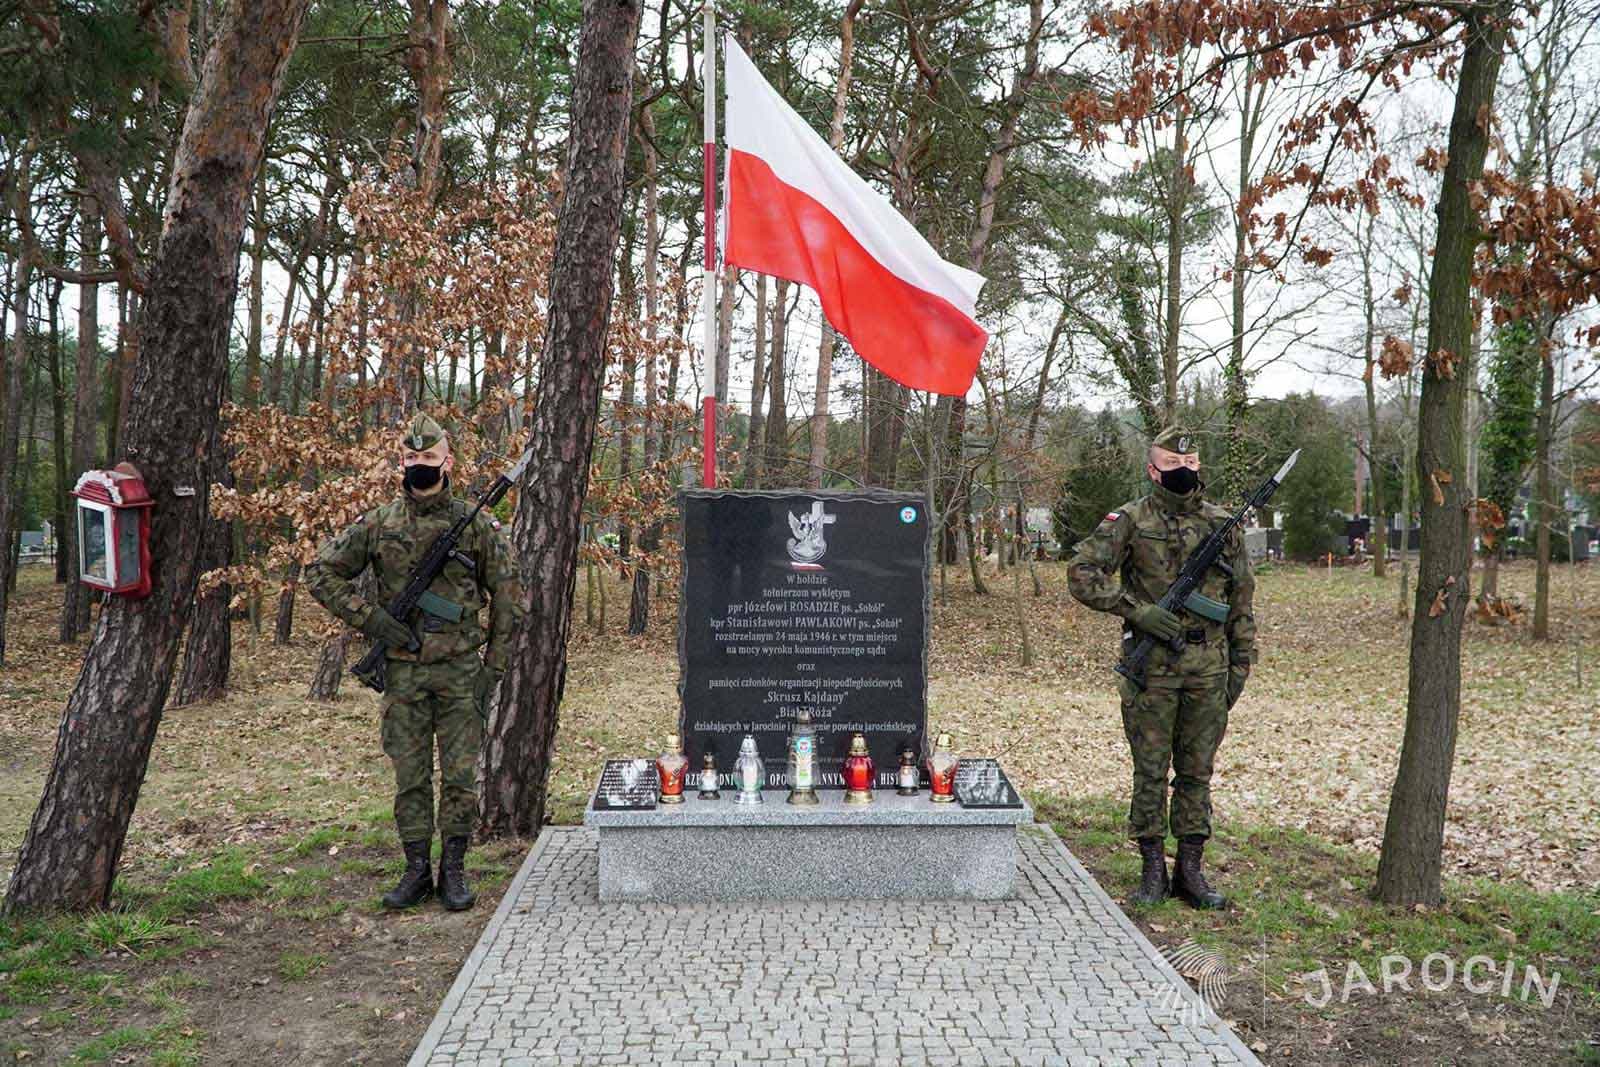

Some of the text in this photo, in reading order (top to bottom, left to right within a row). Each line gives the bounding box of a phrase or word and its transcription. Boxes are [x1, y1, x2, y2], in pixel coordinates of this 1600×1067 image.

[787, 574, 828, 585] W hołdzie
[744, 601, 787, 614] Józefowi
[790, 601, 840, 613] ROSADZIE
[727, 617, 793, 628] Stanisławowi
[795, 617, 857, 628] PAWLAKOWI
[715, 632, 774, 643] rozstrzelanym
[776, 632, 786, 641] 24
[788, 632, 808, 643] maja
[810, 632, 831, 641] 1946
[848, 633, 864, 644] tym
[866, 632, 897, 643] miejscu
[726, 646, 737, 654] na
[738, 646, 761, 656] mocy
[762, 645, 793, 656] wyroku
[794, 645, 865, 656] komunistycznego
[797, 663, 815, 671] oraz
[779, 678, 822, 689] organizacji
[694, 720, 742, 733] działających
[743, 723, 751, 731] w
[752, 721, 787, 732] Jarocinie
[832, 721, 864, 733] powiatu
